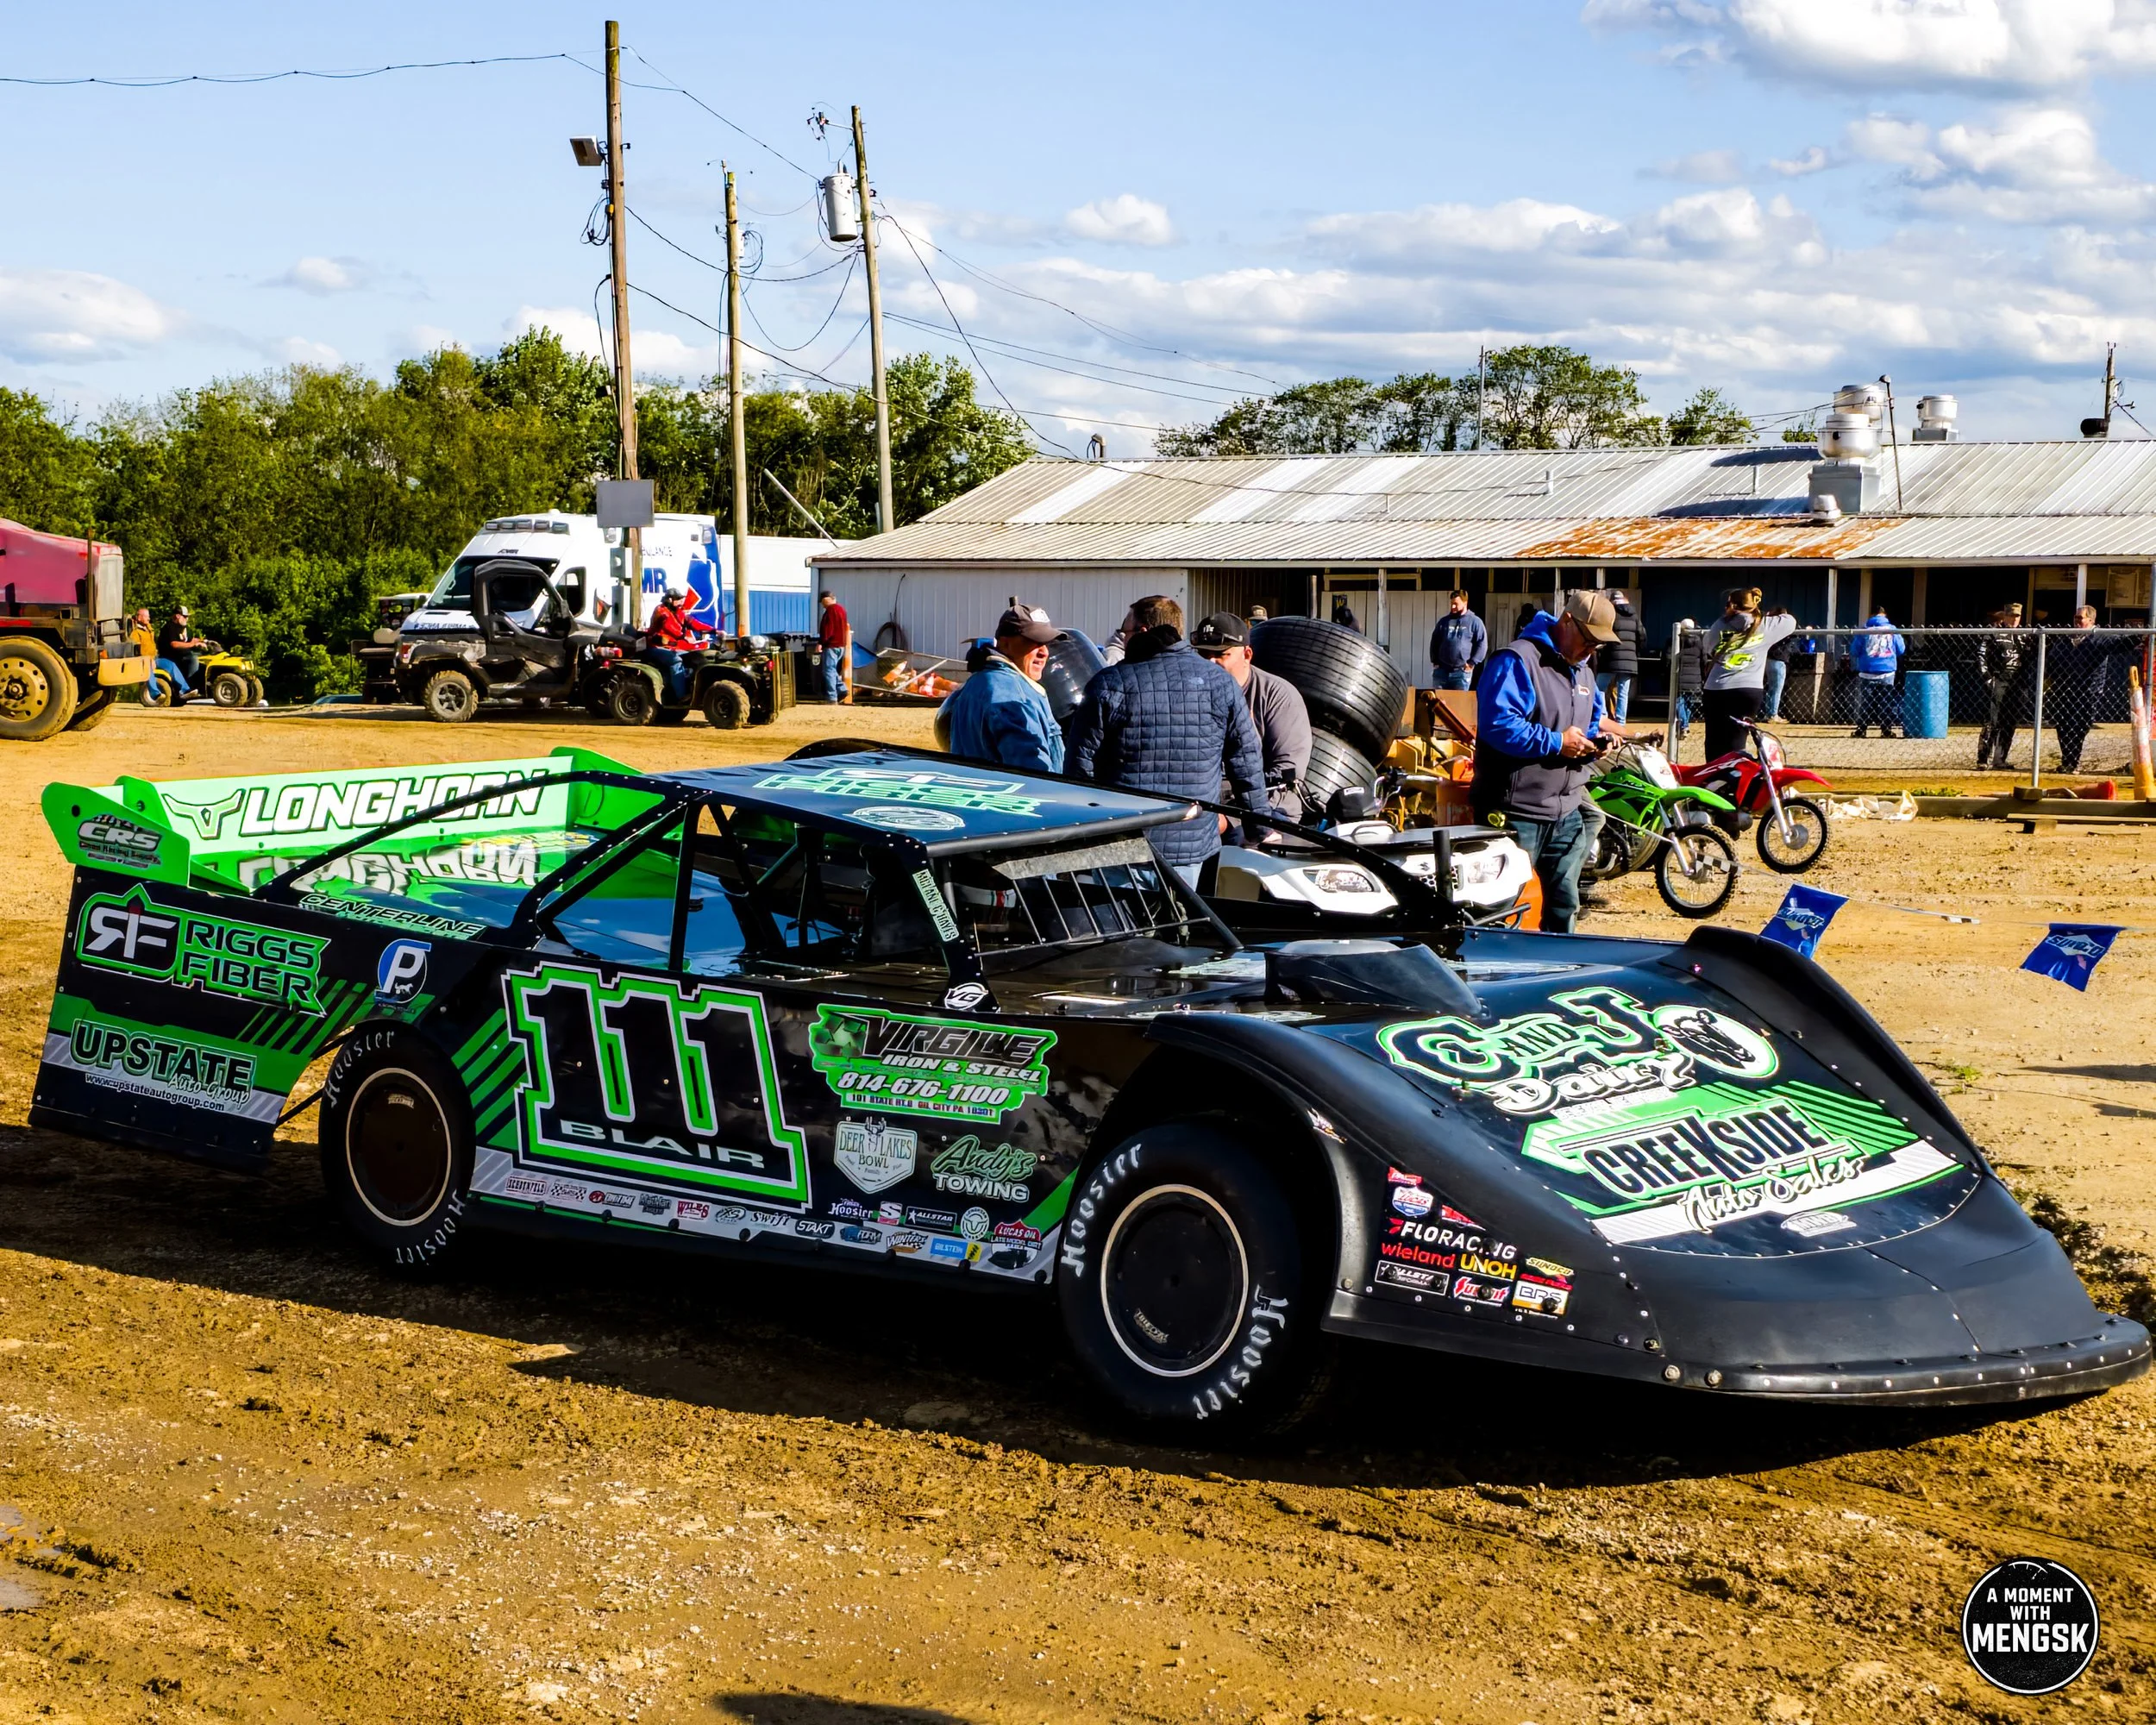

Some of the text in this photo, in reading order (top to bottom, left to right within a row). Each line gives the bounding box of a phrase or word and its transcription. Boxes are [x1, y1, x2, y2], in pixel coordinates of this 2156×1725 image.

[240, 768, 549, 837] LONGHORN
[78, 821, 160, 850] CRS
[301, 894, 487, 936] CENTERLINE
[184, 919, 317, 969] RIGGS
[181, 950, 313, 1002] FIBER
[72, 1021, 255, 1093] UPSTATE
[1497, 1021, 1581, 1058] AND
[323, 1030, 395, 1107] Hoosier
[881, 1054, 941, 1070] IRON
[943, 1061, 961, 1073] &
[85, 1074, 226, 1111] www.upstateautogroup.com
[167, 1072, 250, 1110] Auto Group
[519, 978, 797, 1189] 111
[837, 1072, 1011, 1106] 814-676-1100
[1494, 1053, 1696, 1114] Dairy
[560, 1119, 766, 1170] BLAIR
[839, 1130, 866, 1154] DEER
[880, 1134, 913, 1161] LAKES
[858, 1154, 890, 1169] BOWL
[932, 1135, 1037, 1181] Andy's
[1583, 1105, 1829, 1194] CREEKSIDE
[934, 1173, 1030, 1203] TOWING
[1680, 1154, 1865, 1234] Auto Sales
[750, 1210, 792, 1227] Swift
[828, 1202, 874, 1218] Hoosier
[916, 1211, 955, 1222] ALLSTAR
[1061, 1143, 1143, 1277] Hoosier
[999, 1226, 1024, 1237] LUCAS
[1024, 1229, 1037, 1239] OIL
[1401, 1221, 1518, 1259] FLORACNG
[1381, 1242, 1456, 1268] wieland
[1460, 1253, 1517, 1280] UNOH
[1528, 1258, 1572, 1275] SUNOCO
[1193, 1283, 1290, 1421] Hoosier
